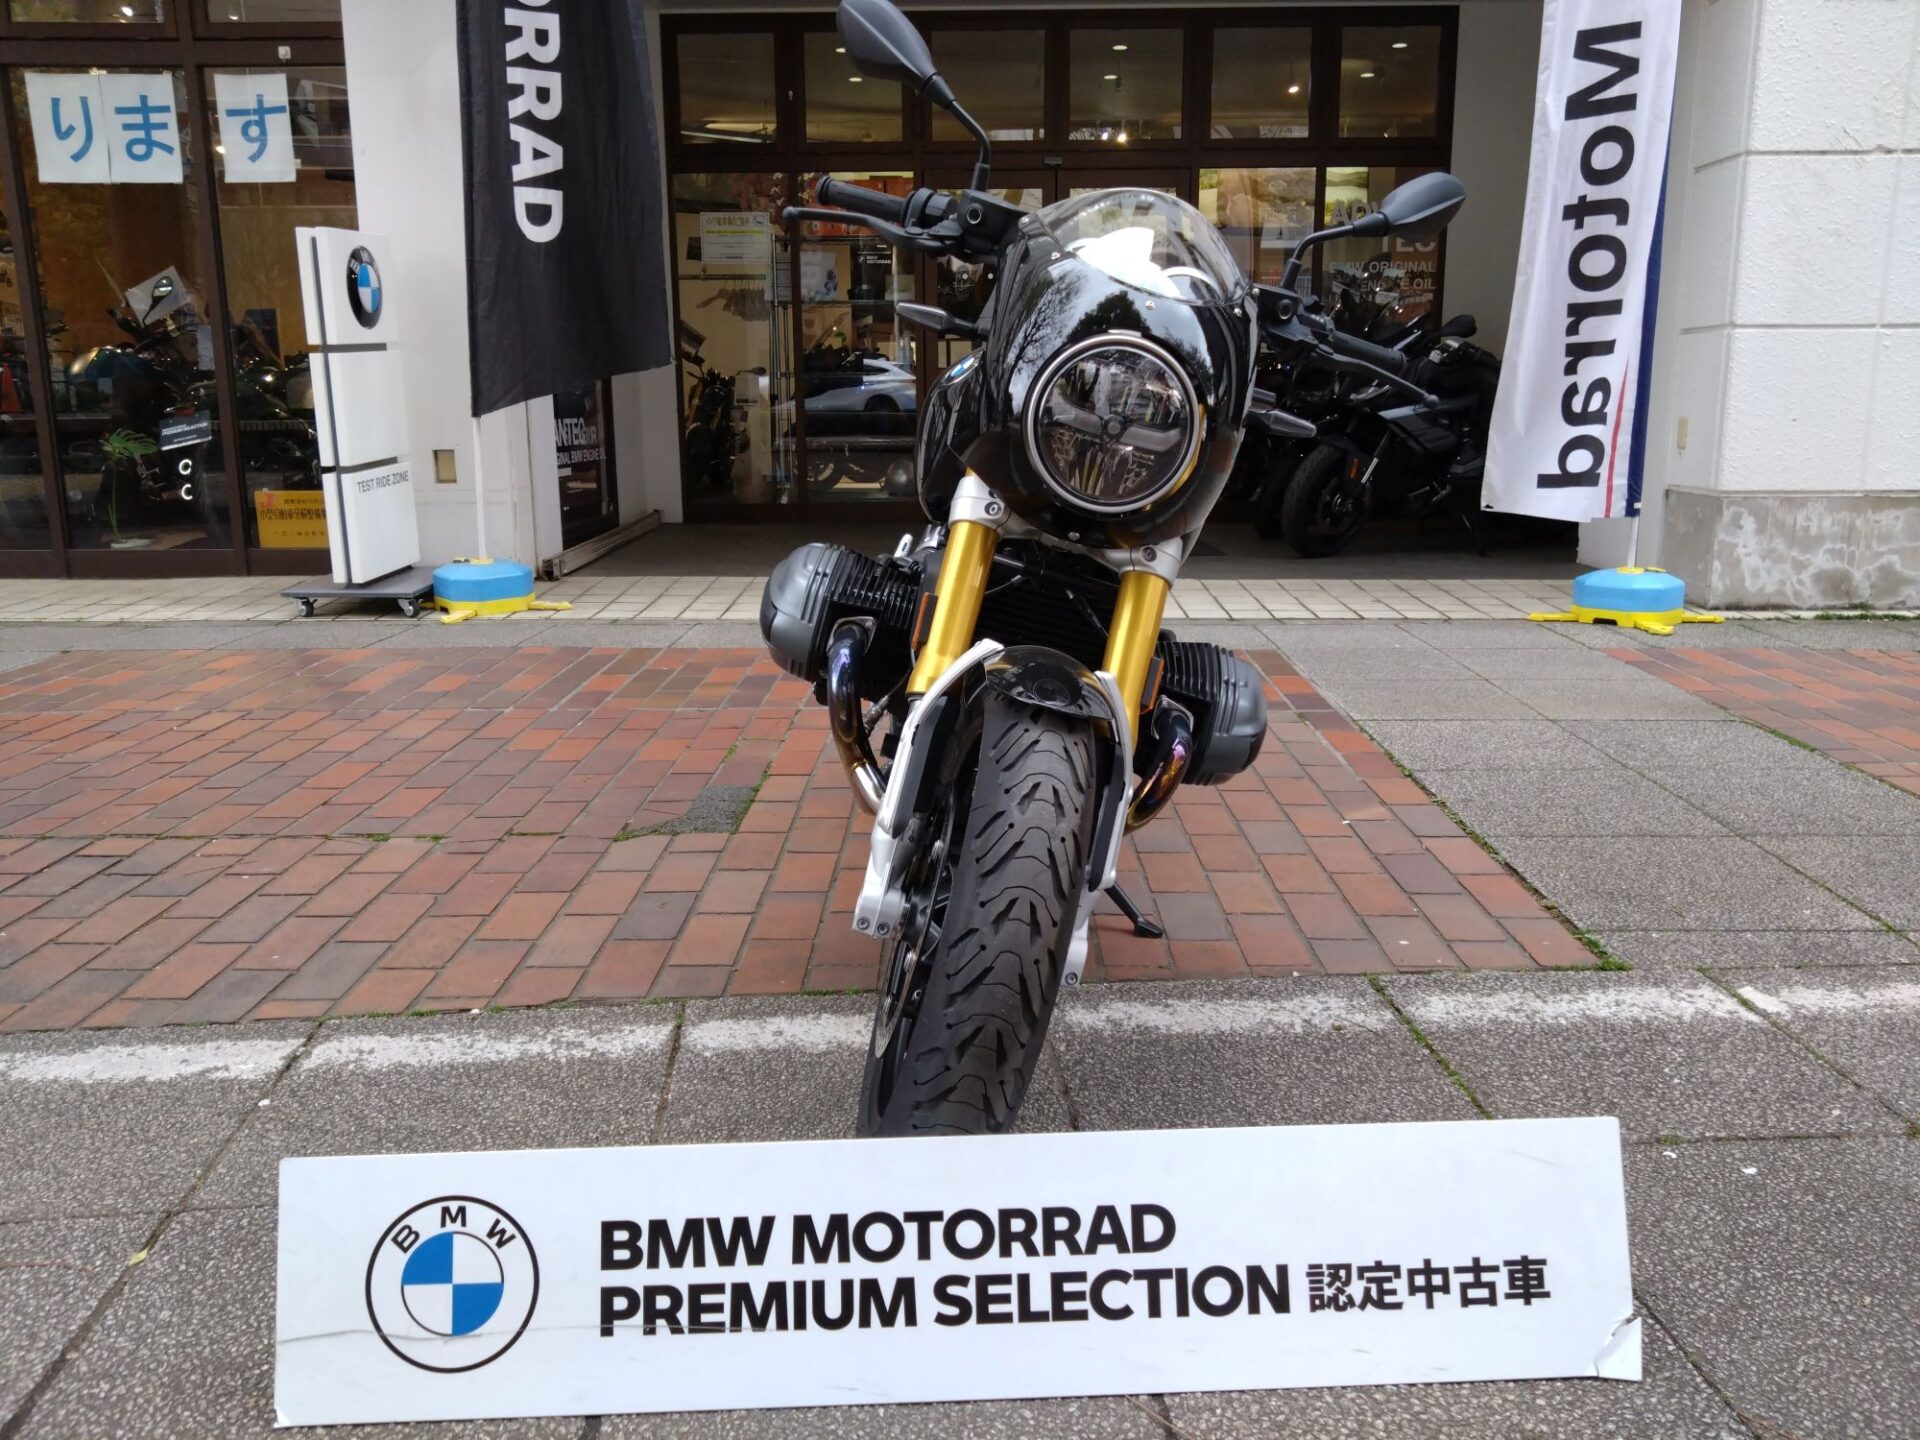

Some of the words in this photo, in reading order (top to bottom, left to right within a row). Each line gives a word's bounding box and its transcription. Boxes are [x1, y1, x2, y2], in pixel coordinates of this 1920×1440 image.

[504, 0, 563, 243] RRAD
[357, 478, 375, 493] TEST
[376, 474, 391, 488] RIDE
[391, 470, 409, 484] ZONE
[391, 1204, 517, 1255] BMW
[600, 1216, 776, 1271] BMW
[791, 1203, 1177, 1265] MOTORRAD
[600, 1277, 918, 1337] PREMIUM
[933, 1265, 1292, 1326] SELECTION
[1306, 1255, 1552, 1313] 認定中古車
